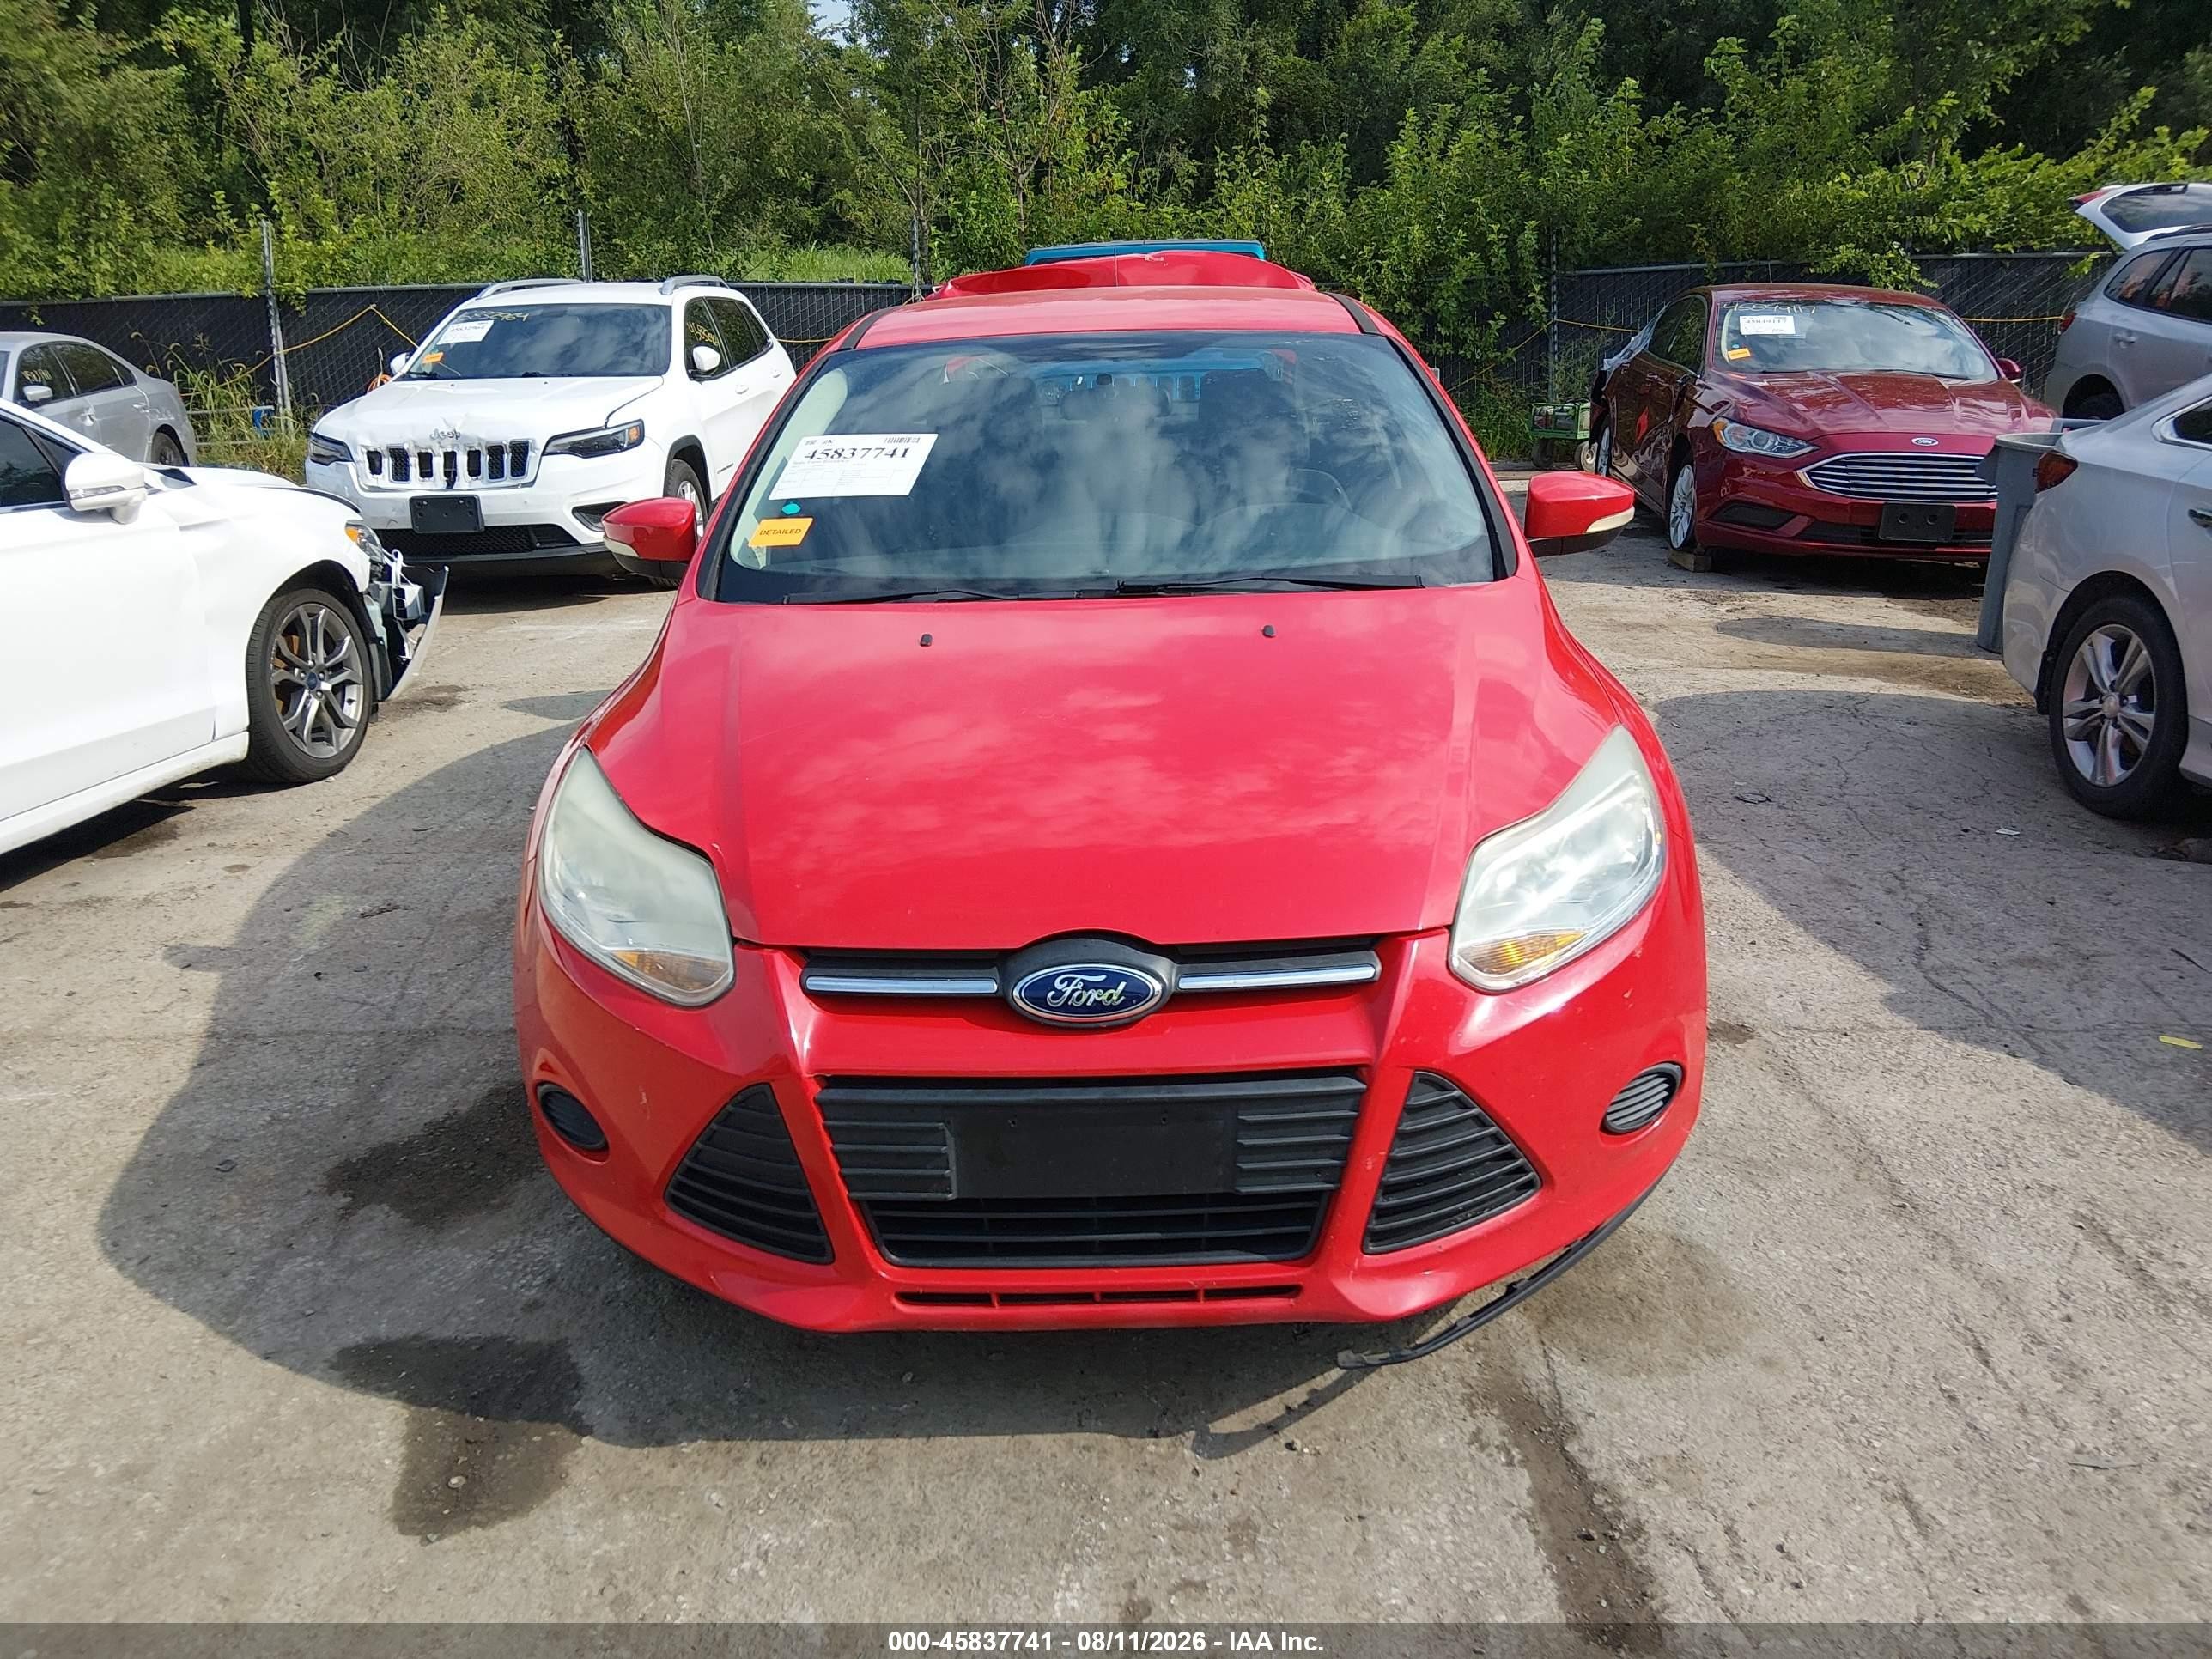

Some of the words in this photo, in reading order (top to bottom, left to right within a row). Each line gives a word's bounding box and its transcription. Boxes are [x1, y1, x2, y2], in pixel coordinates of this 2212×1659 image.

[429, 428, 461, 441] Jeep
[804, 447, 910, 460] 45837741
[1046, 974, 1127, 1007] Ford
